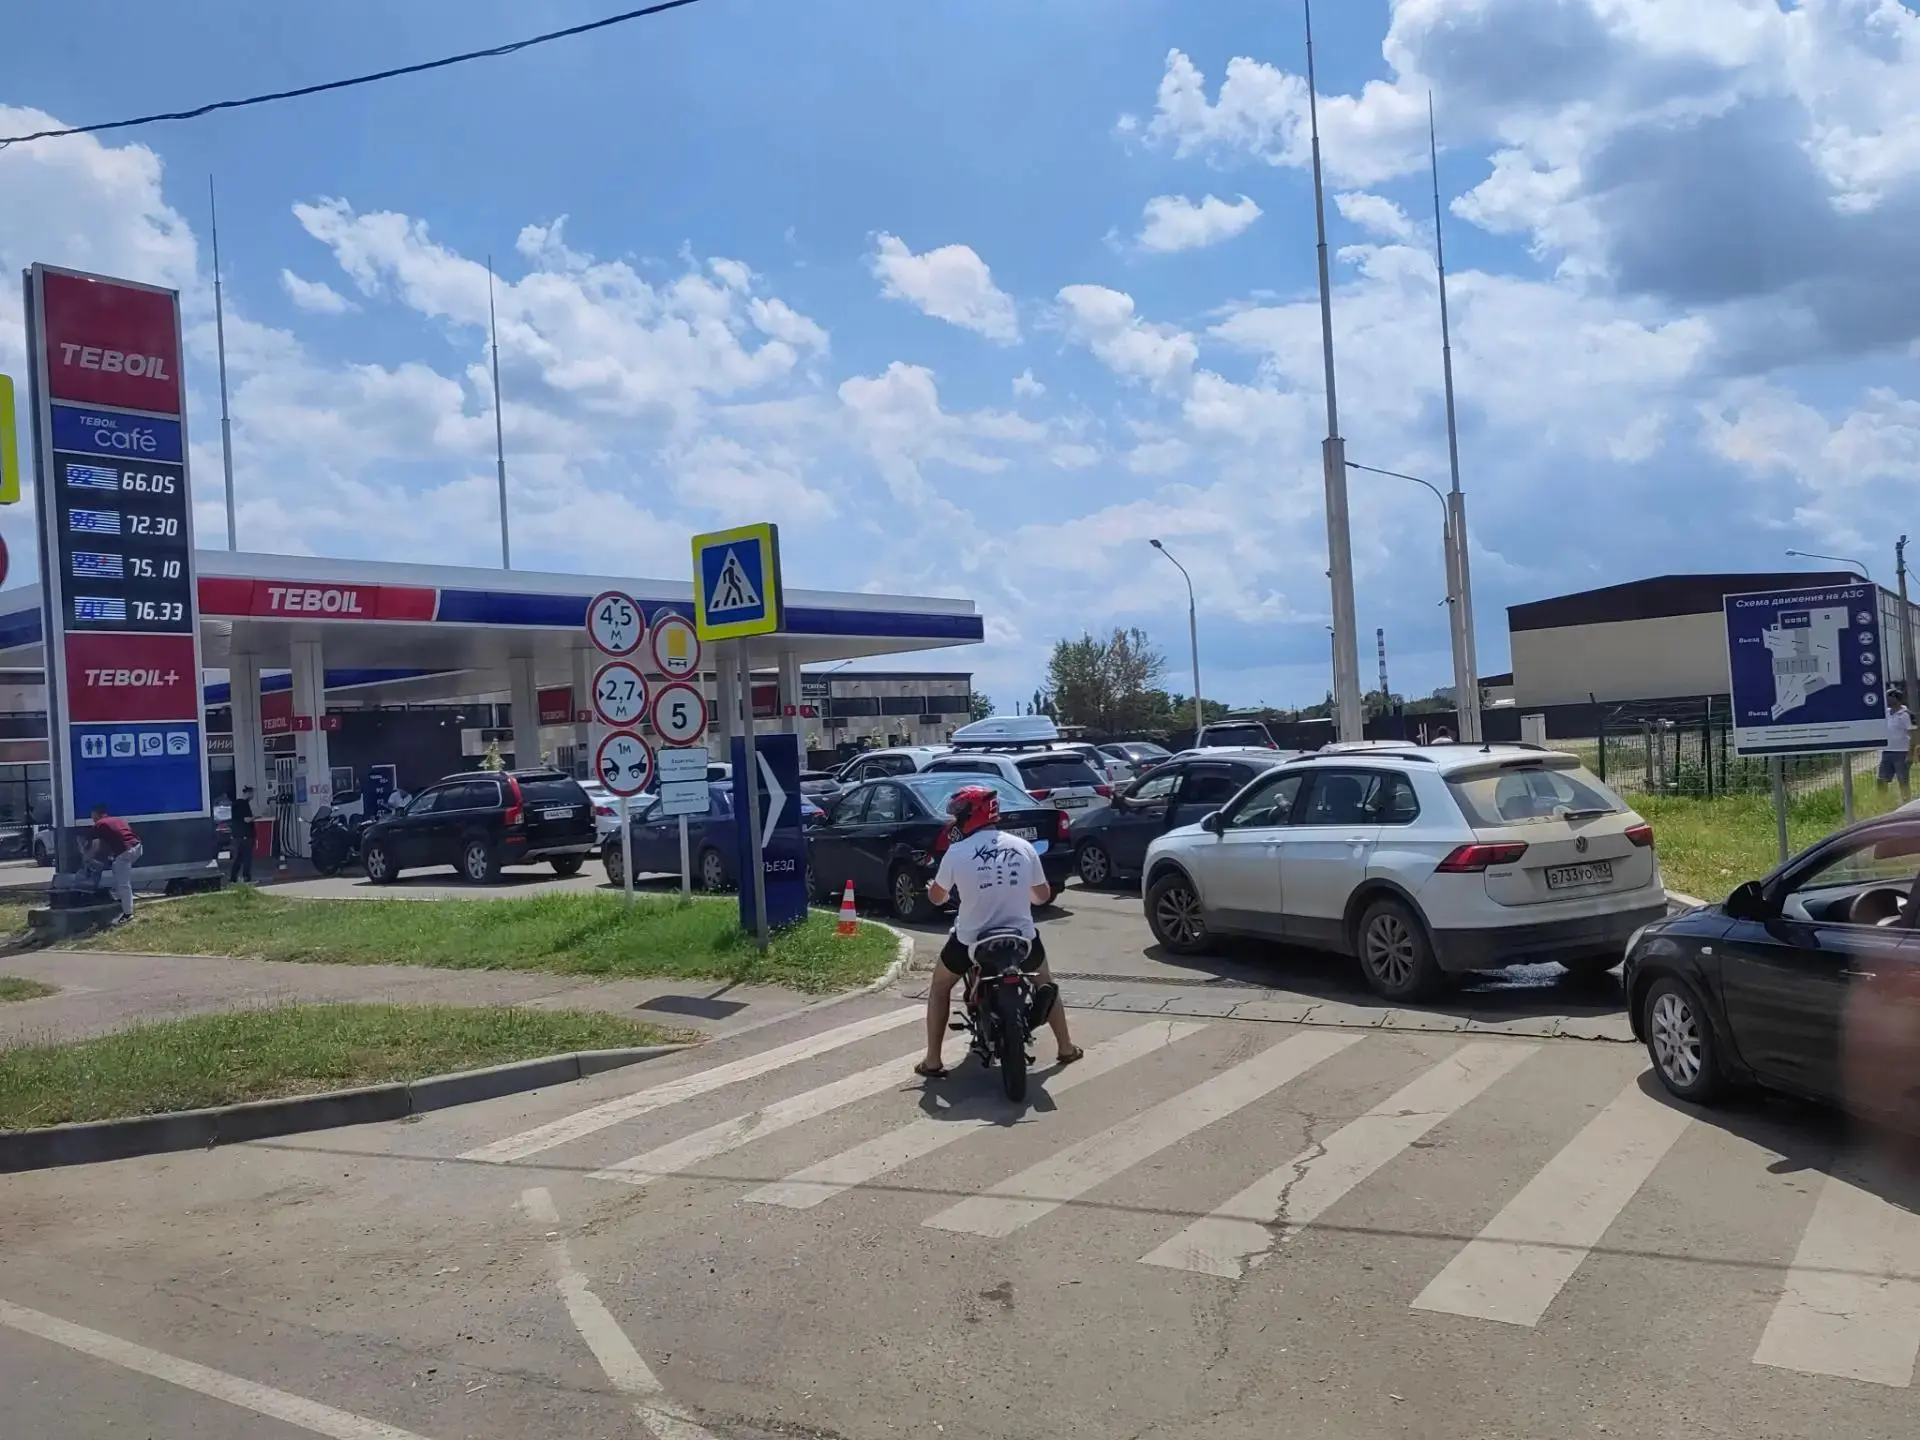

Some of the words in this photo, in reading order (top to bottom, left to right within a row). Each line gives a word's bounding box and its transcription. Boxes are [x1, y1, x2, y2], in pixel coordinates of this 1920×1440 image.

[60, 342, 169, 380] TEBOIL
[79, 415, 118, 428] TEBOIL
[94, 429, 157, 451] café
[122, 472, 175, 494] 66.05
[126, 515, 178, 536] 72.30
[129, 558, 181, 579] 75.10
[268, 587, 363, 612] TEBOIL
[1736, 600, 1769, 608] Схема
[1772, 595, 1824, 606] движения
[1841, 589, 1864, 599] АЗС
[131, 601, 183, 621] 76.33
[600, 604, 632, 628] 4,5
[85, 669, 180, 687] TEBOIL+
[606, 680, 636, 703] 2,7
[330, 718, 337, 728] 2
[671, 703, 687, 729] 5
